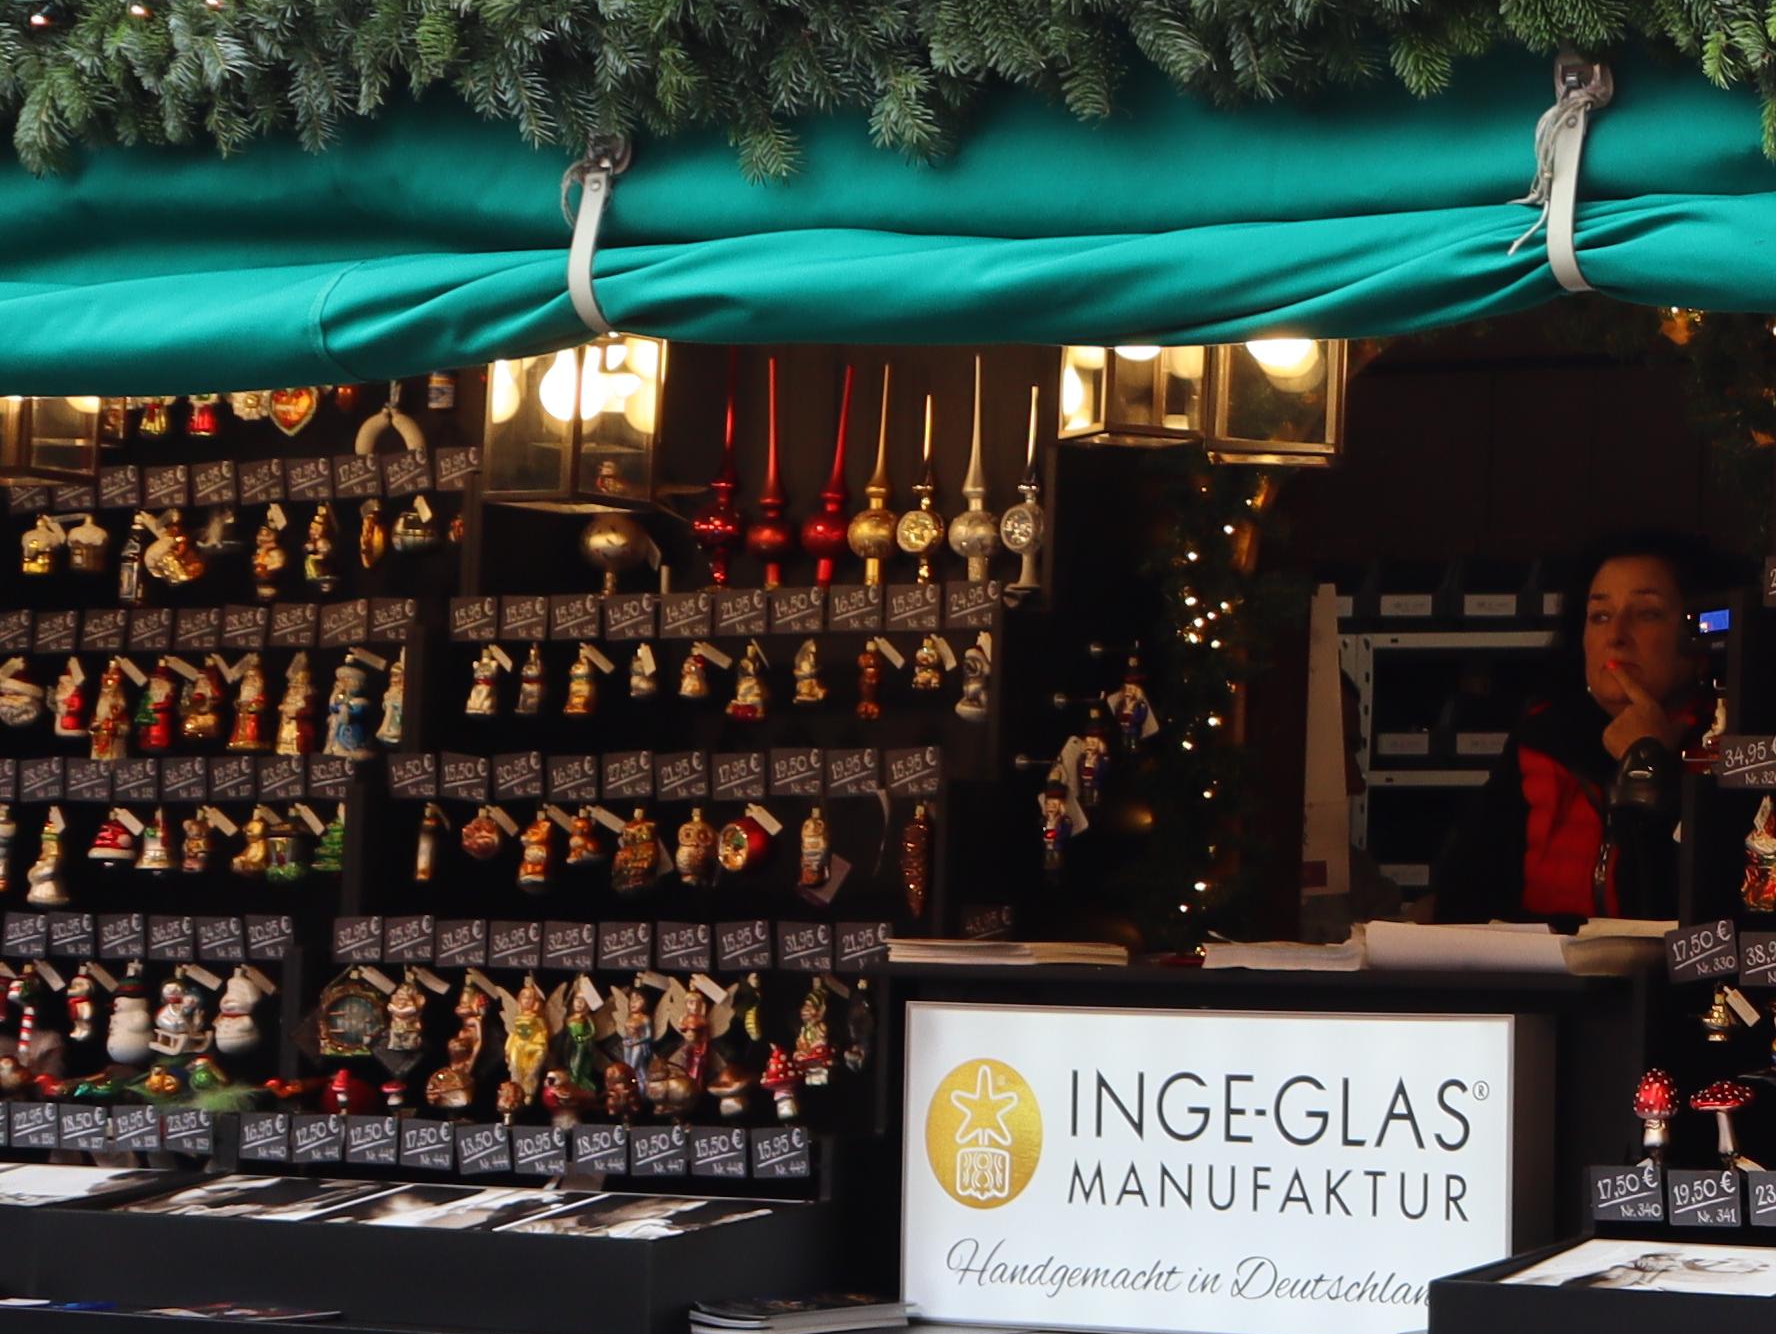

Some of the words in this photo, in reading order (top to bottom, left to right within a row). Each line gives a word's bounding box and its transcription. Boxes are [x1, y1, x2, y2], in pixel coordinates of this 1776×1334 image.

[552, 1127, 565, 1145] €
[732, 1129, 743, 1149] €
[1066, 1158, 1470, 1223] MANUFAKTUR
[945, 1237, 1182, 1299] Handgemacht
[1188, 1265, 1222, 1296] in
[1229, 1256, 1430, 1307] Deutschlan
